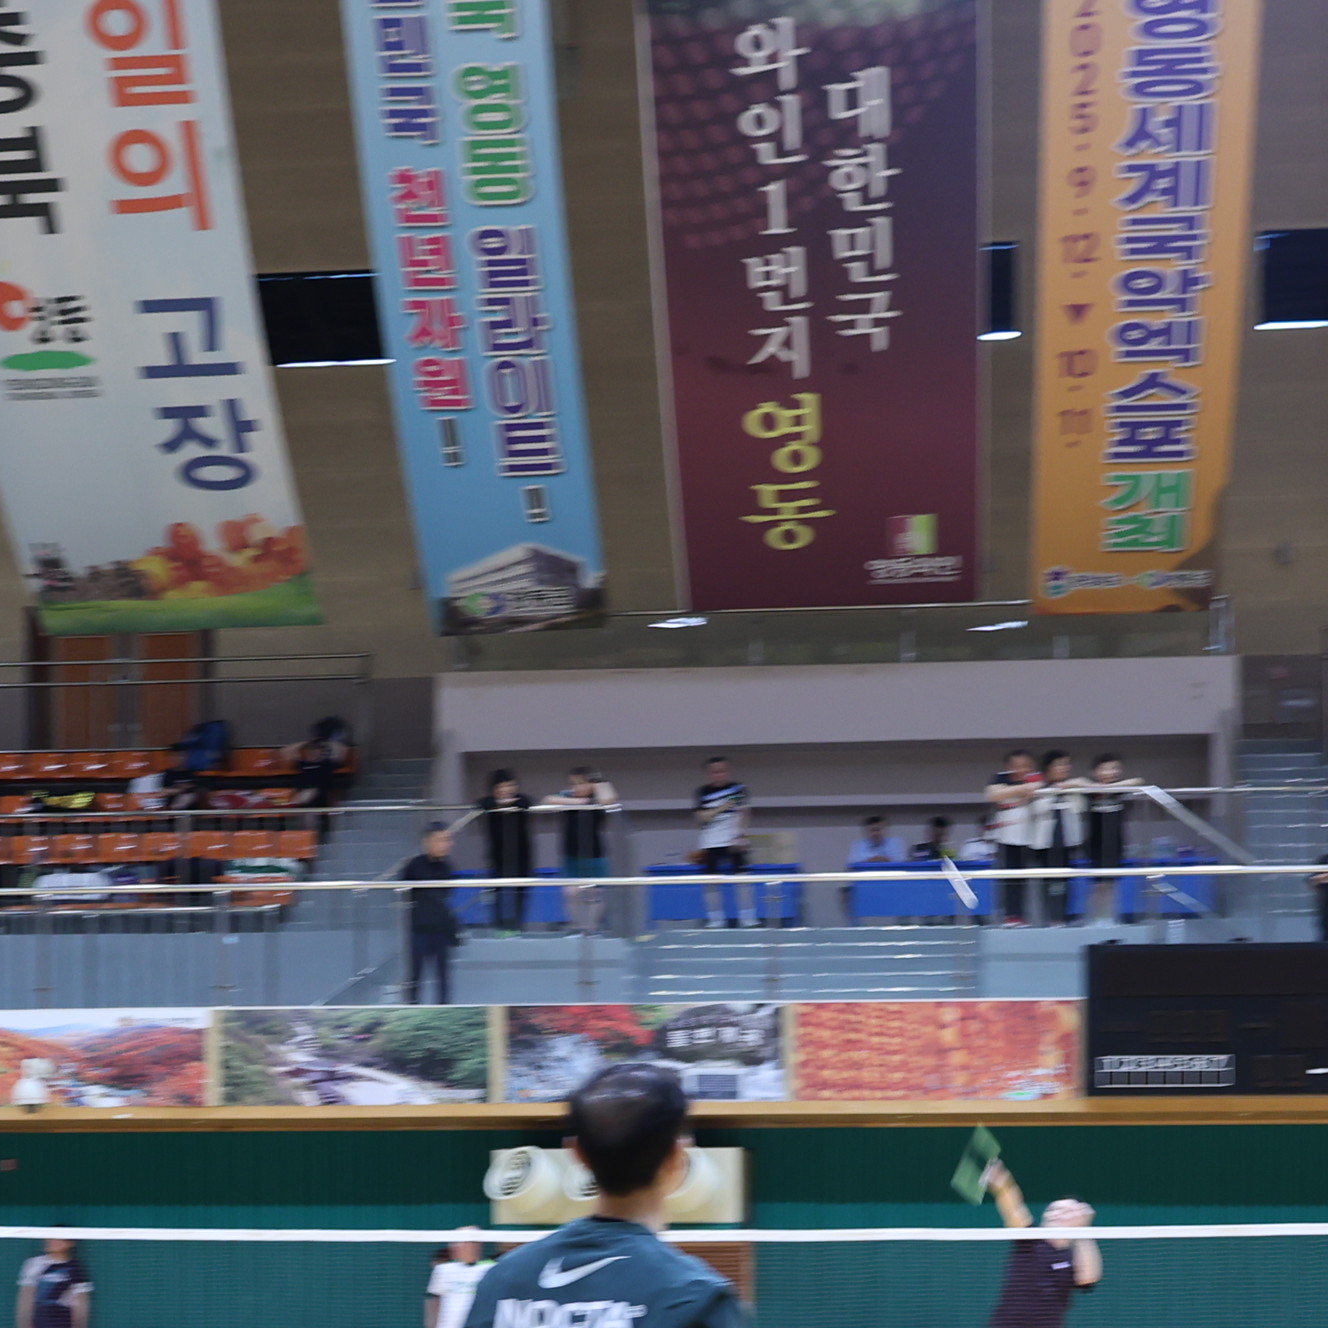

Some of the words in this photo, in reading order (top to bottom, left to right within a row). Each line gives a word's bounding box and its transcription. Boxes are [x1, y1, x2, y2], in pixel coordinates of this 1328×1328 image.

[453, 61, 535, 206] 영동
[823, 65, 903, 352] 대한민국
[135, 297, 262, 492] 고장
[740, 393, 836, 551] 영동
[1100, 469, 1196, 553] 개최
